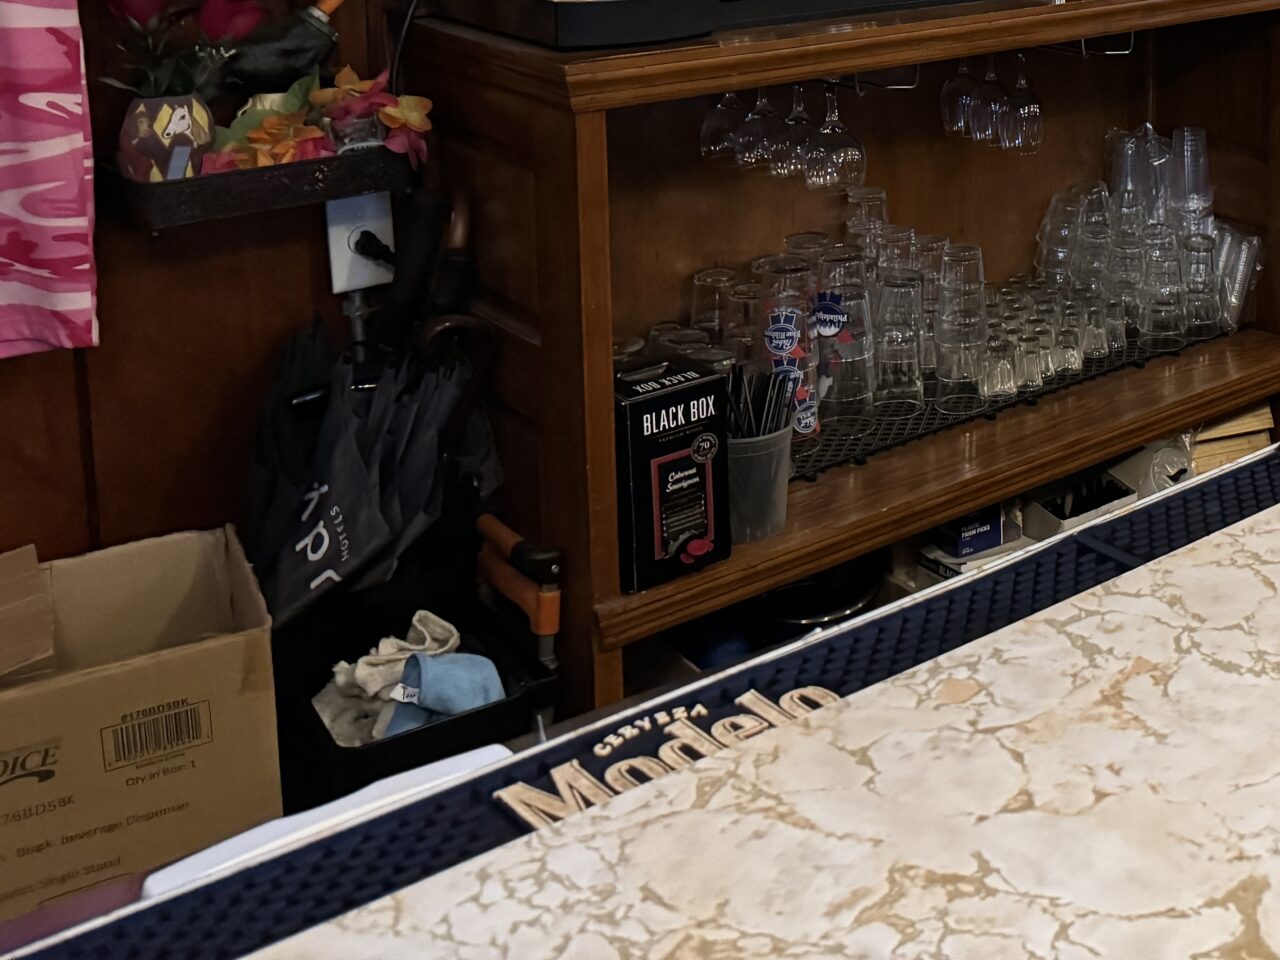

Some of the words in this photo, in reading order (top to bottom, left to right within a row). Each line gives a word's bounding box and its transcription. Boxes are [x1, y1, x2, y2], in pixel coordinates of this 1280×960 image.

[632, 381, 660, 394] BOX
[663, 371, 701, 387] BLACK
[643, 403, 686, 436] BLACK
[690, 395, 716, 422] BOX
[665, 476, 701, 493] Sauvignon
[668, 467, 697, 483] Cabernet
[330, 505, 350, 561] HOTELS
[593, 703, 709, 757] CERVEZA
[492, 685, 843, 831] Modelo
